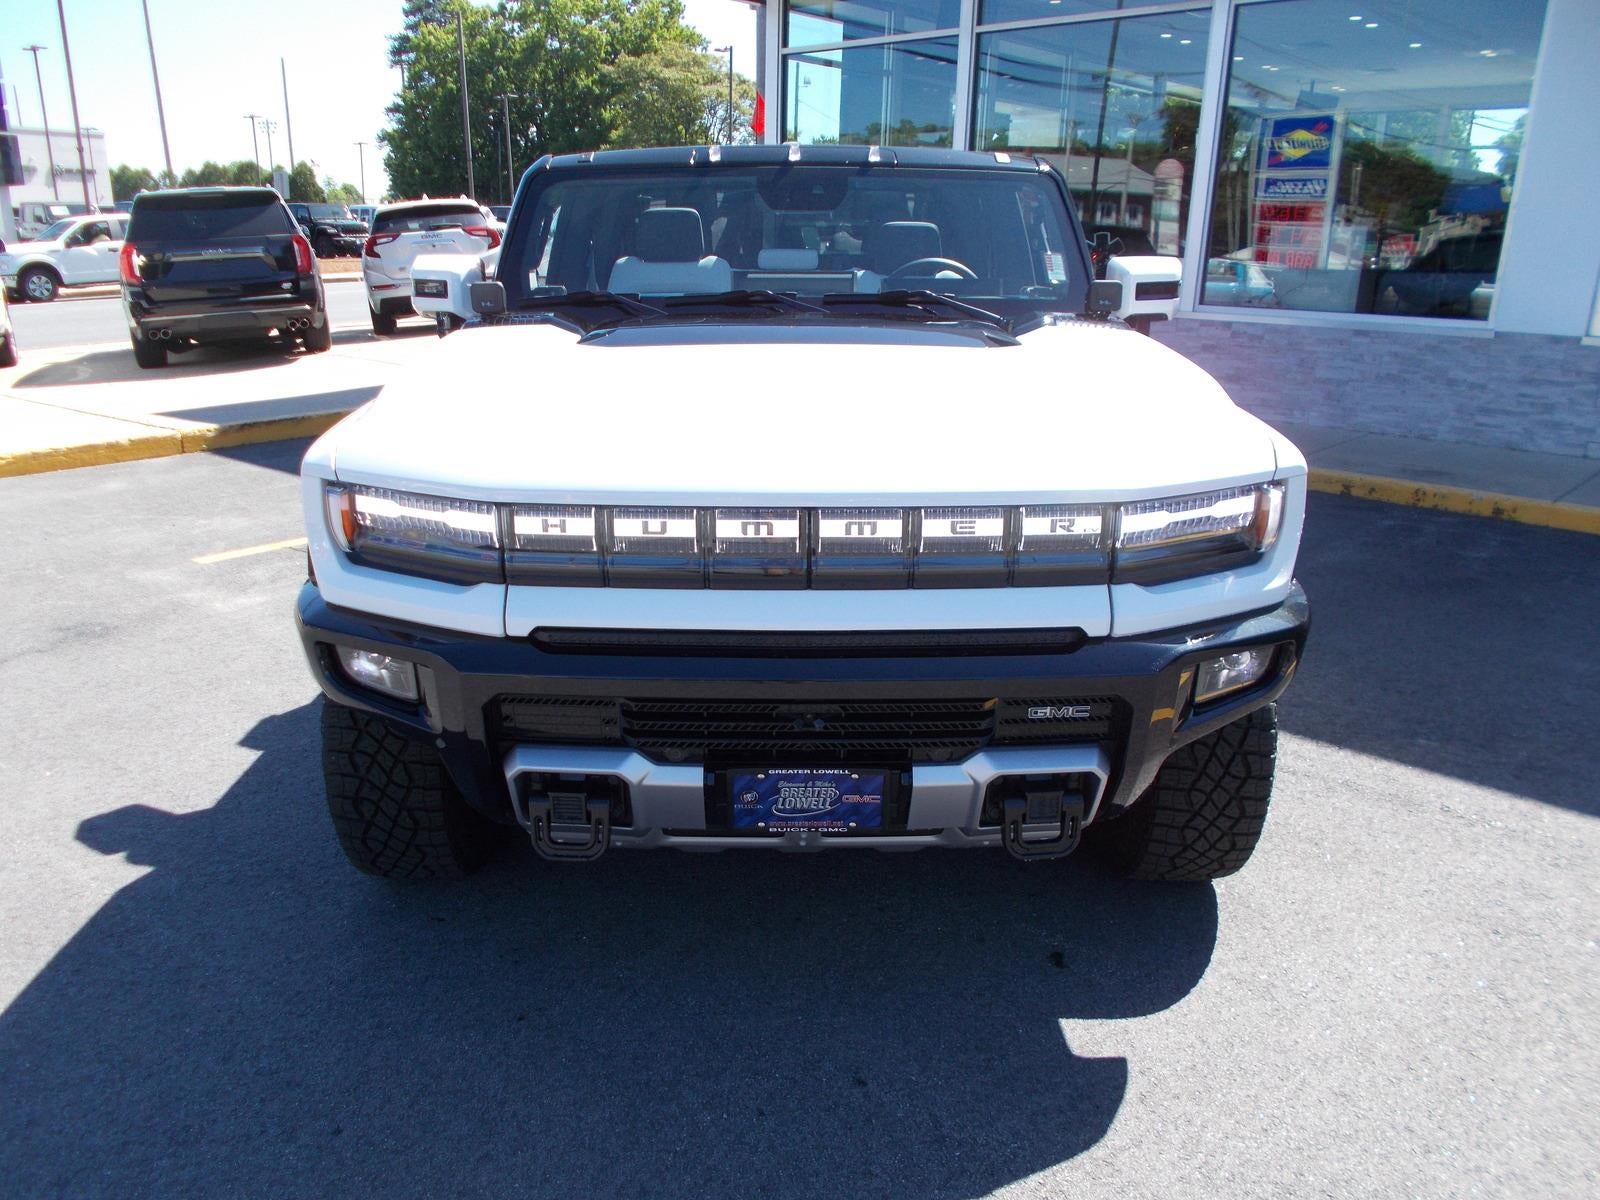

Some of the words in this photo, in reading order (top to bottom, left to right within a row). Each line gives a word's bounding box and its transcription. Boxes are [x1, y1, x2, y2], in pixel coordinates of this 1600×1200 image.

[541, 518, 1075, 536] HUMMER
[1028, 706, 1091, 718] GMC
[780, 788, 835, 798] GREATER
[777, 798, 831, 809] LOWELL
[842, 795, 880, 804] GMC
